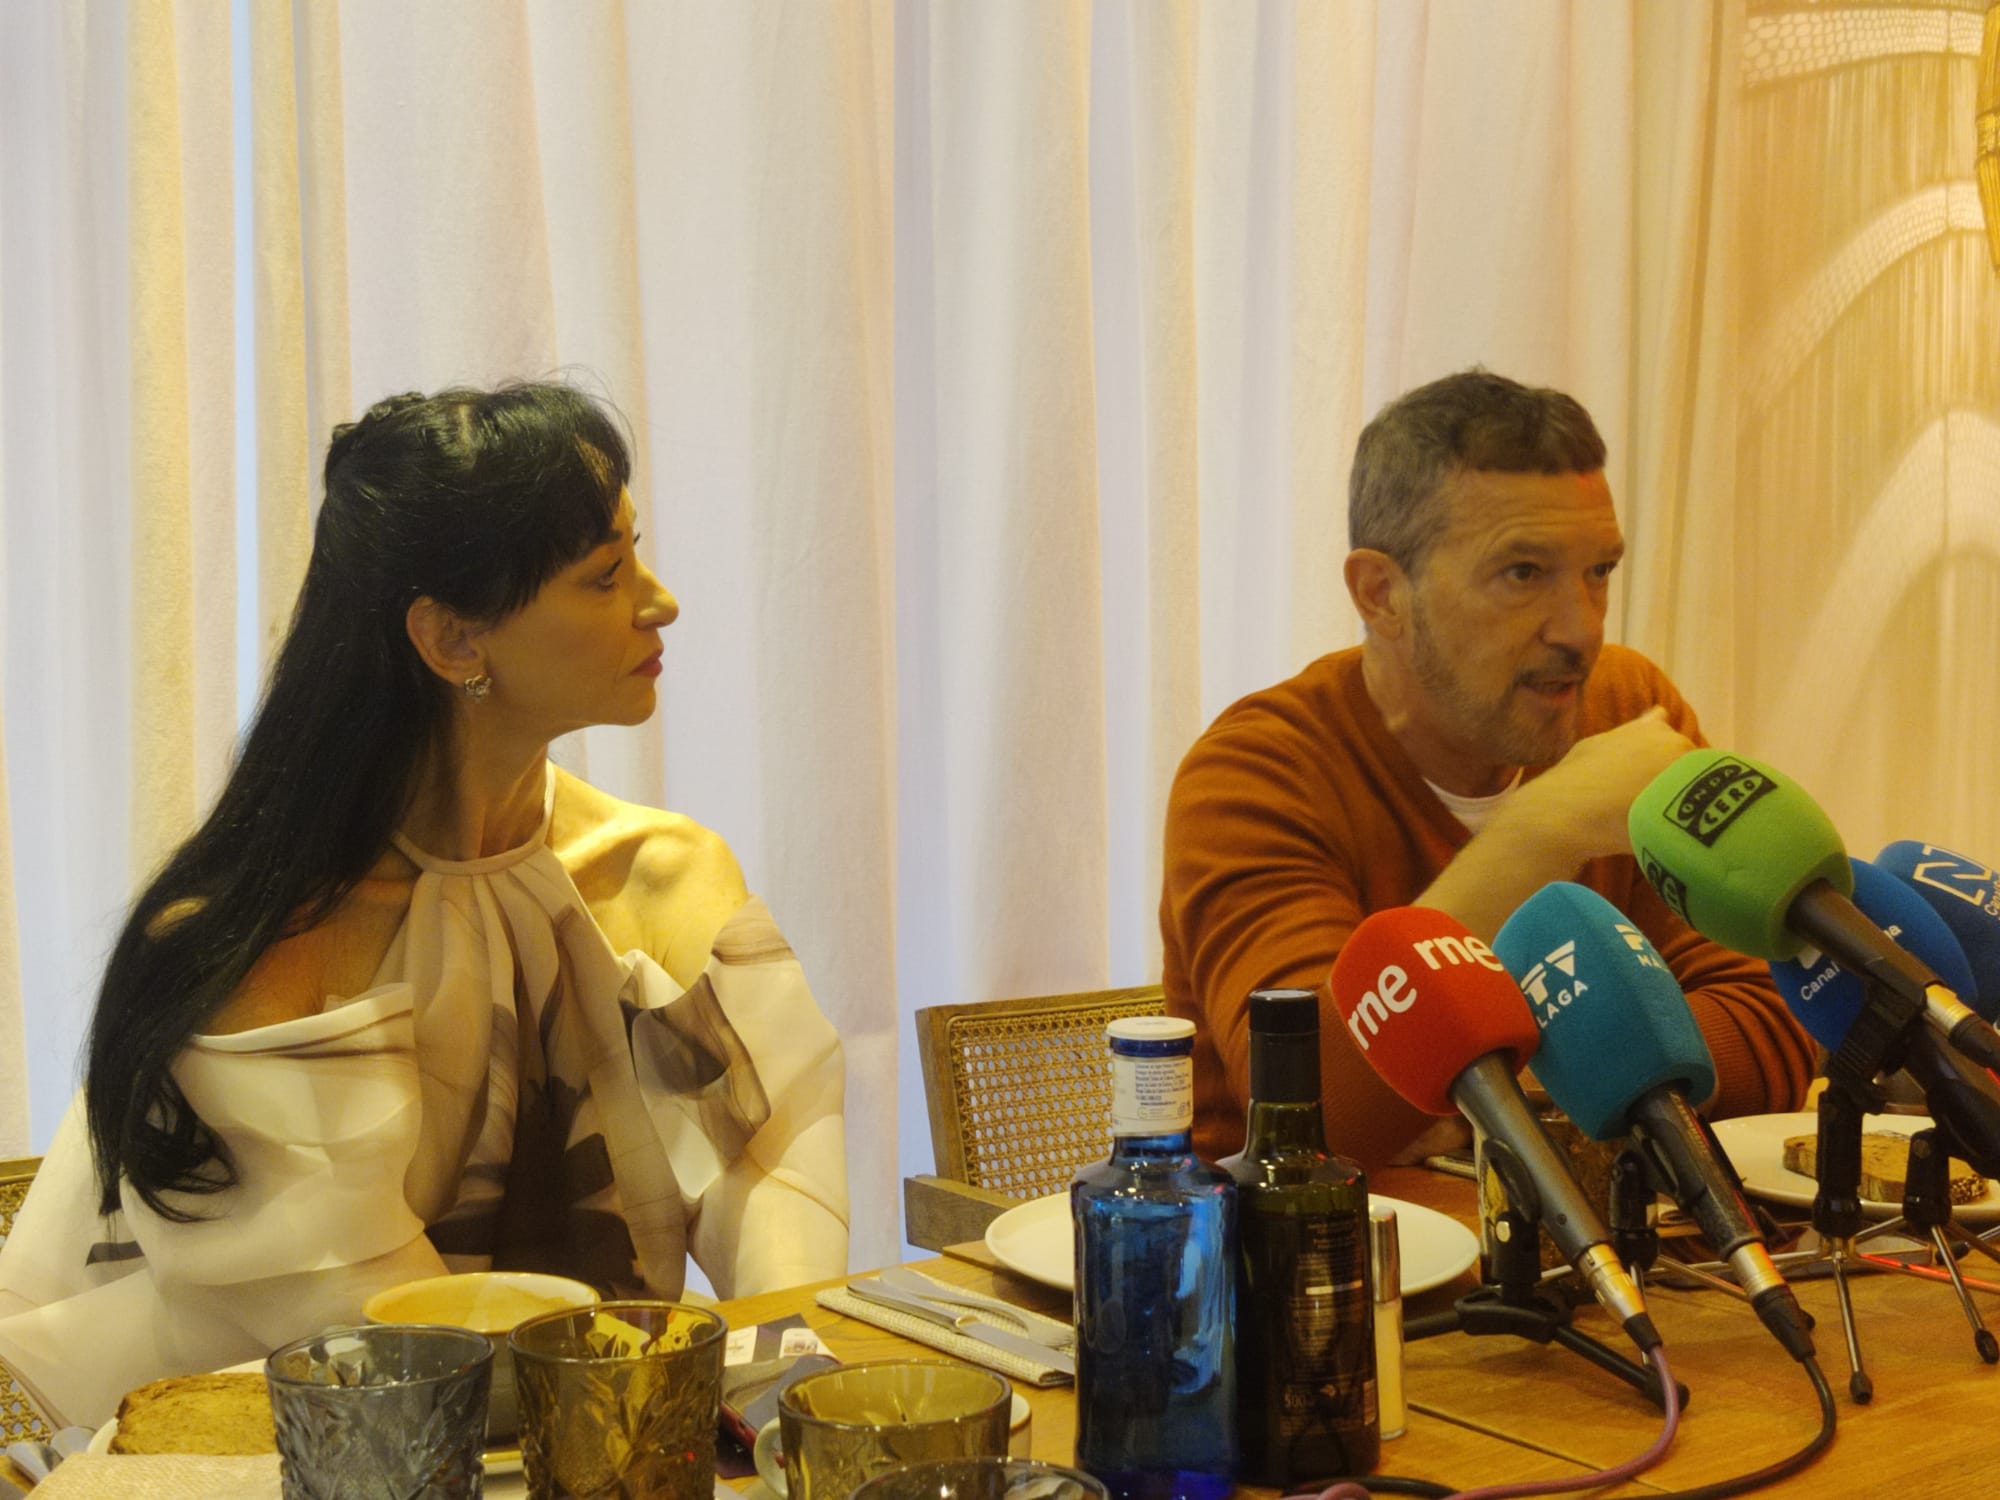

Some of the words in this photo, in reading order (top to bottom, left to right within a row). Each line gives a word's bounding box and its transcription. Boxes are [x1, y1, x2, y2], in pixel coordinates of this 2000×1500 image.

[1681, 767, 1735, 814] ONDA
[1703, 779, 1756, 825] CERO
[1412, 935, 1505, 972] rne
[1520, 939, 1576, 1006] TV
[1536, 979, 1589, 1029] LAGA
[1800, 961, 1841, 1001] Canal
[1347, 964, 1417, 1051] rne
